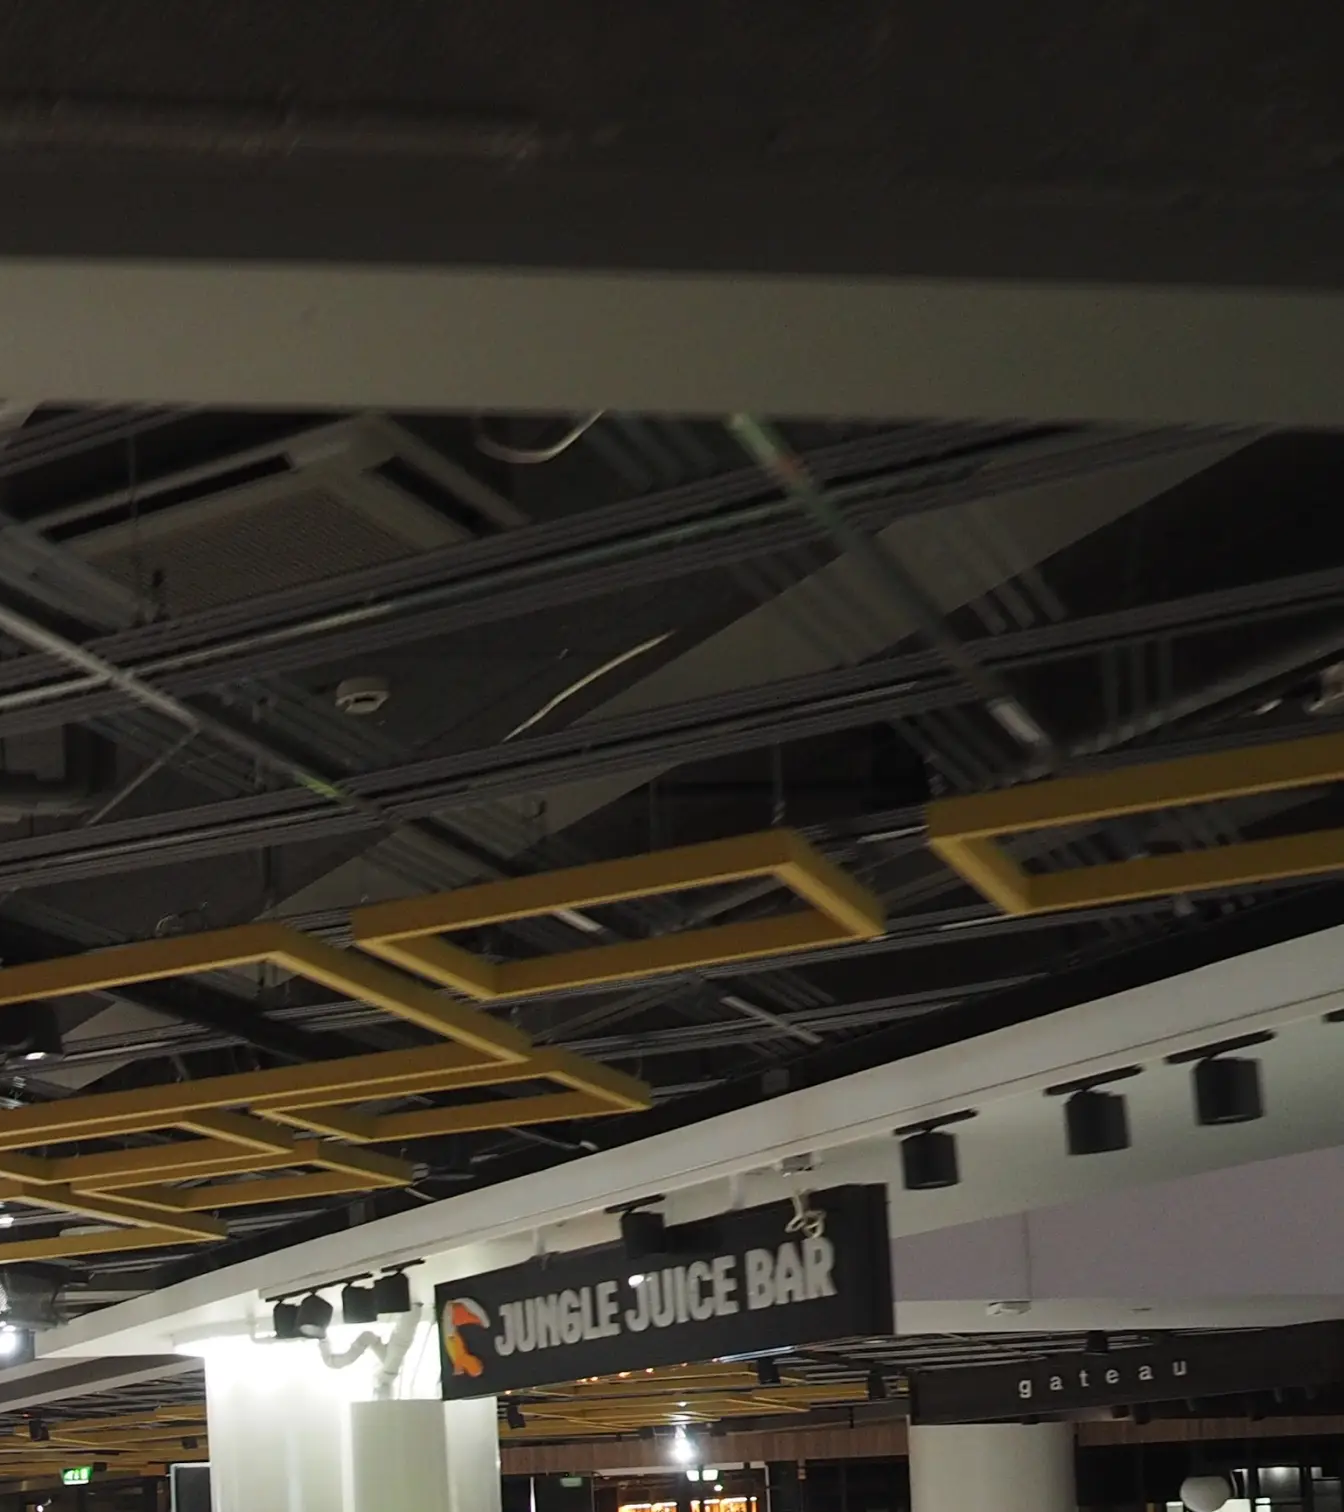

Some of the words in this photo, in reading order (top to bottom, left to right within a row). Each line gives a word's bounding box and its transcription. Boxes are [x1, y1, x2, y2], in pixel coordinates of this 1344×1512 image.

[494, 1280, 621, 1356] JUNGLE
[625, 1255, 739, 1332] JUICE
[745, 1236, 837, 1310] BAR
[1019, 1360, 1187, 1398] gateau
